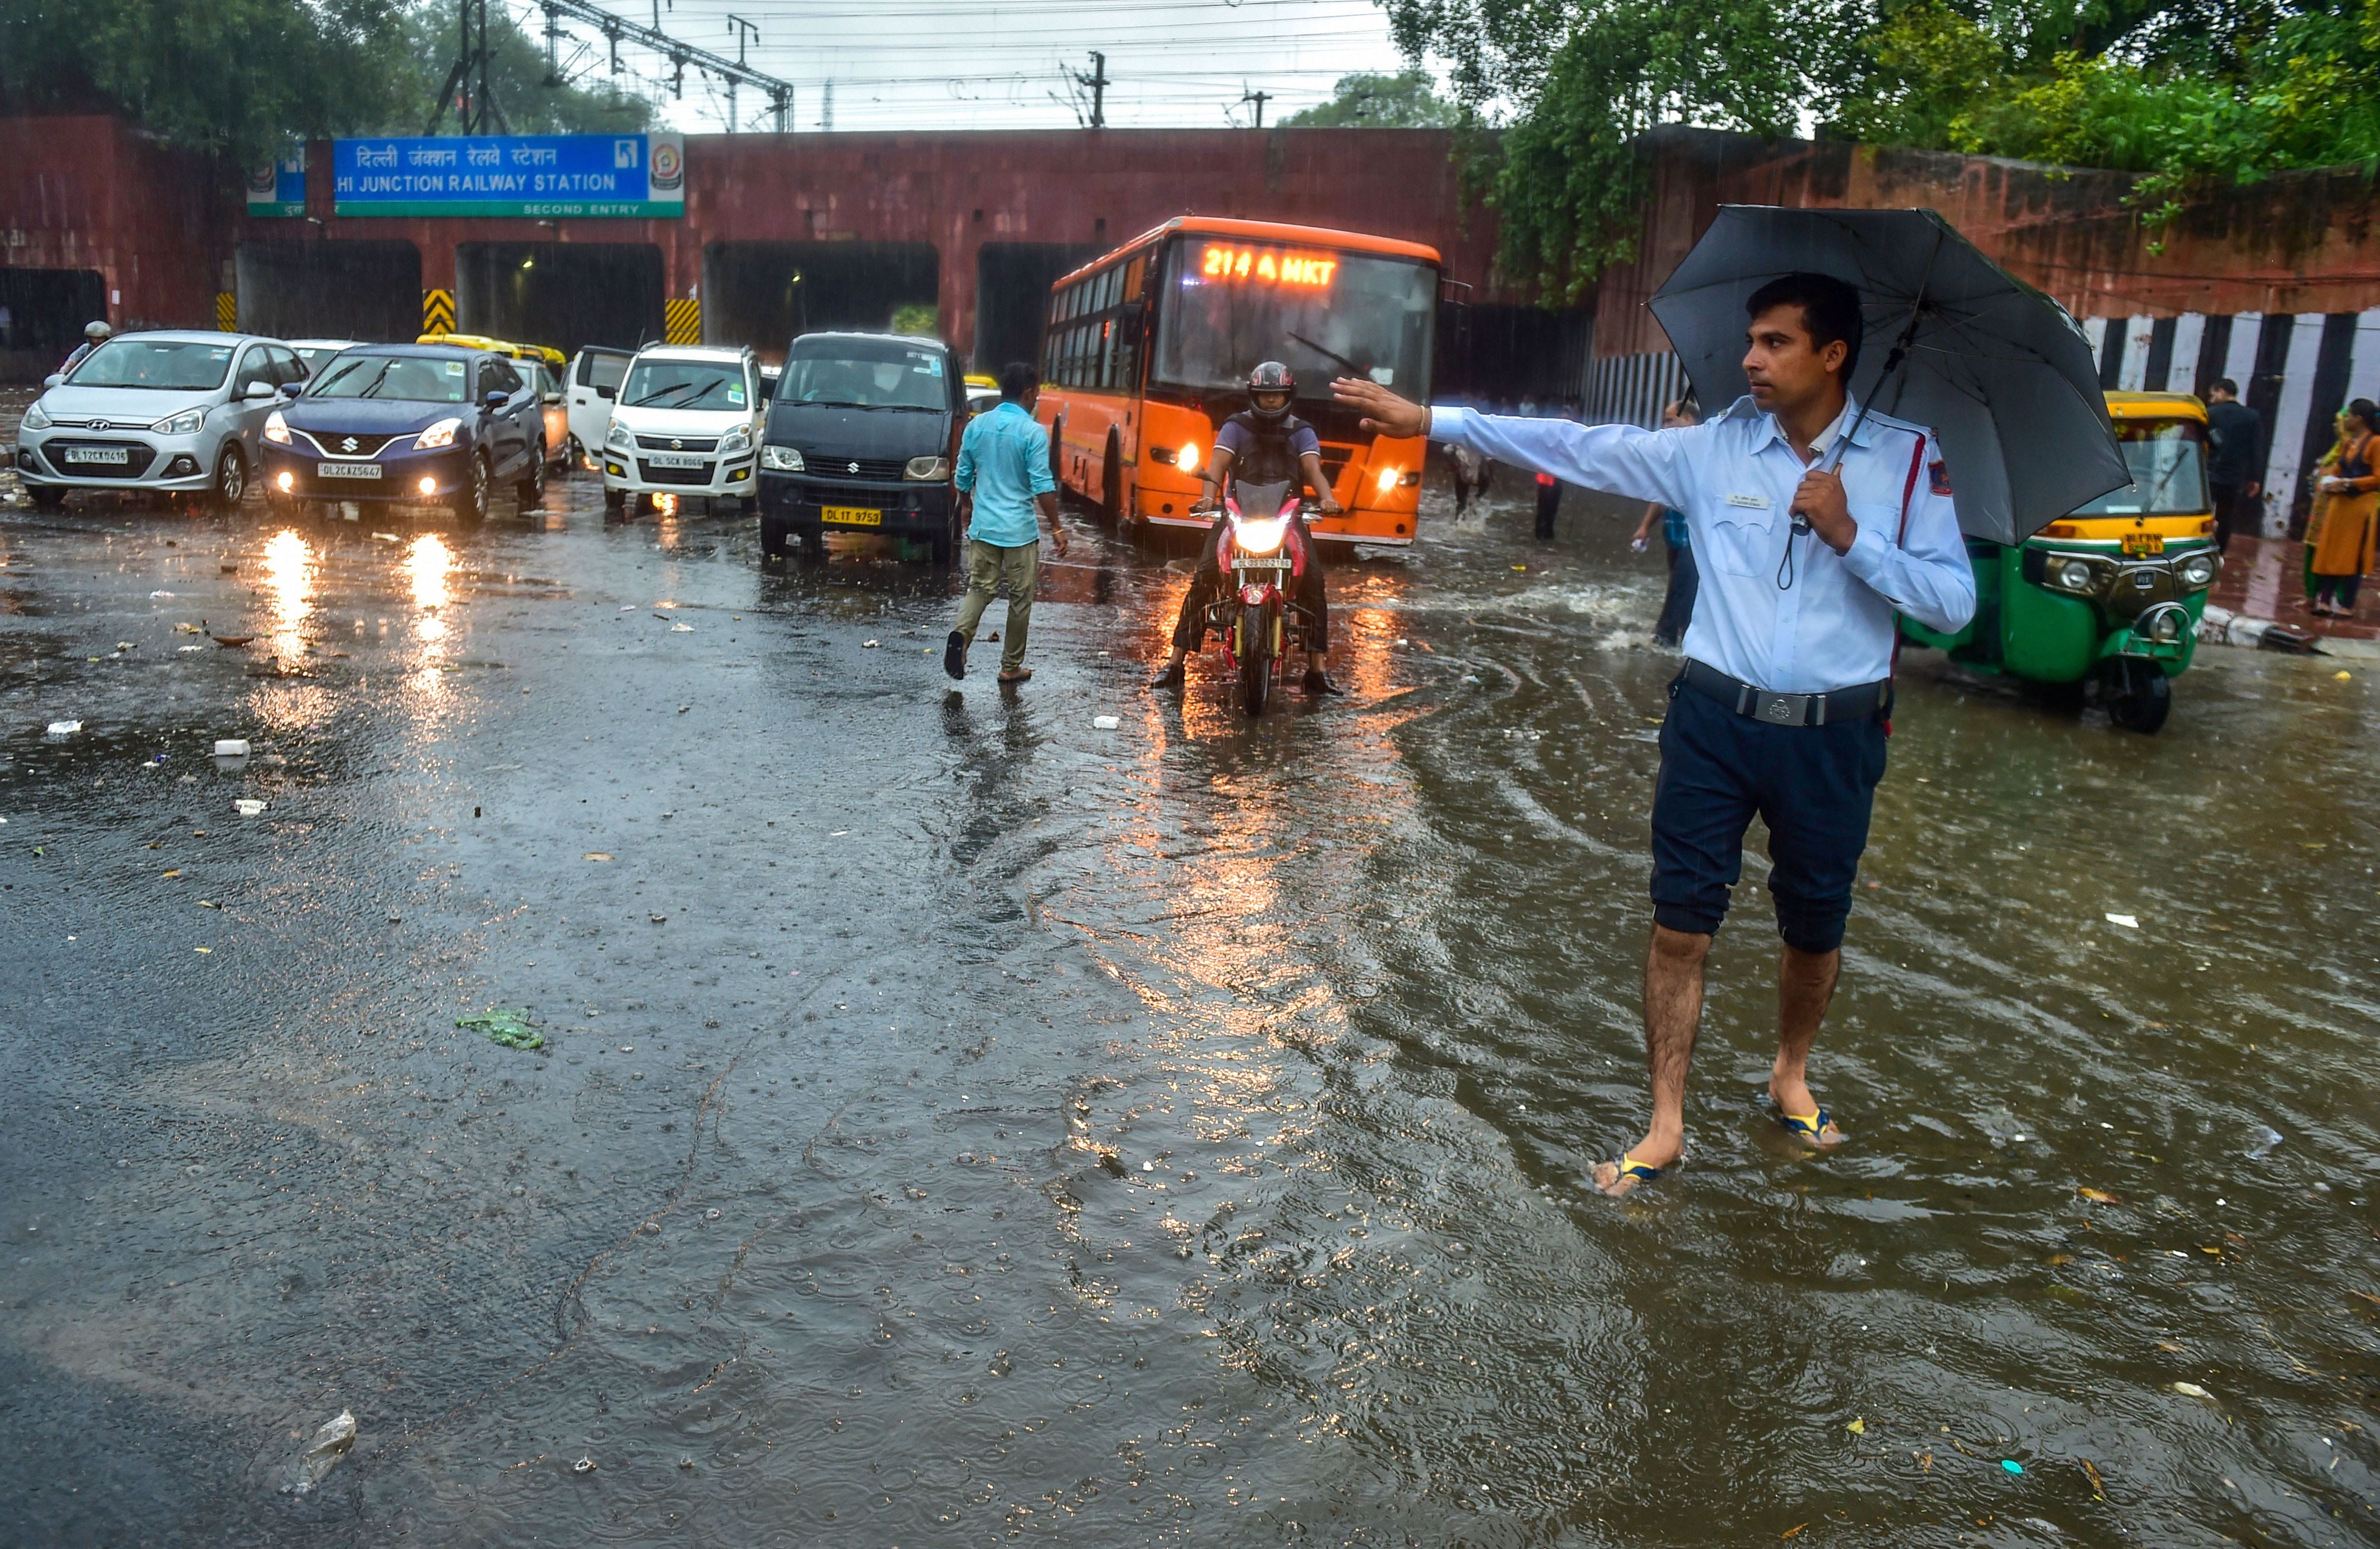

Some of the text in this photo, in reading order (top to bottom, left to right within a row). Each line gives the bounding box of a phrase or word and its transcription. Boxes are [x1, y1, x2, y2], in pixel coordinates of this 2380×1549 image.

[356, 143, 557, 168] दिल्ली जंक्शन रेलवे स्टेशन
[358, 175, 444, 192] JUNCTION
[448, 174, 526, 191] RAILWAY
[535, 173, 615, 191] STATION
[524, 203, 639, 215] SECOND ENTRY
[1204, 248, 1335, 285] 214 A MKT
[827, 510, 879, 522] DL 1T 9753
